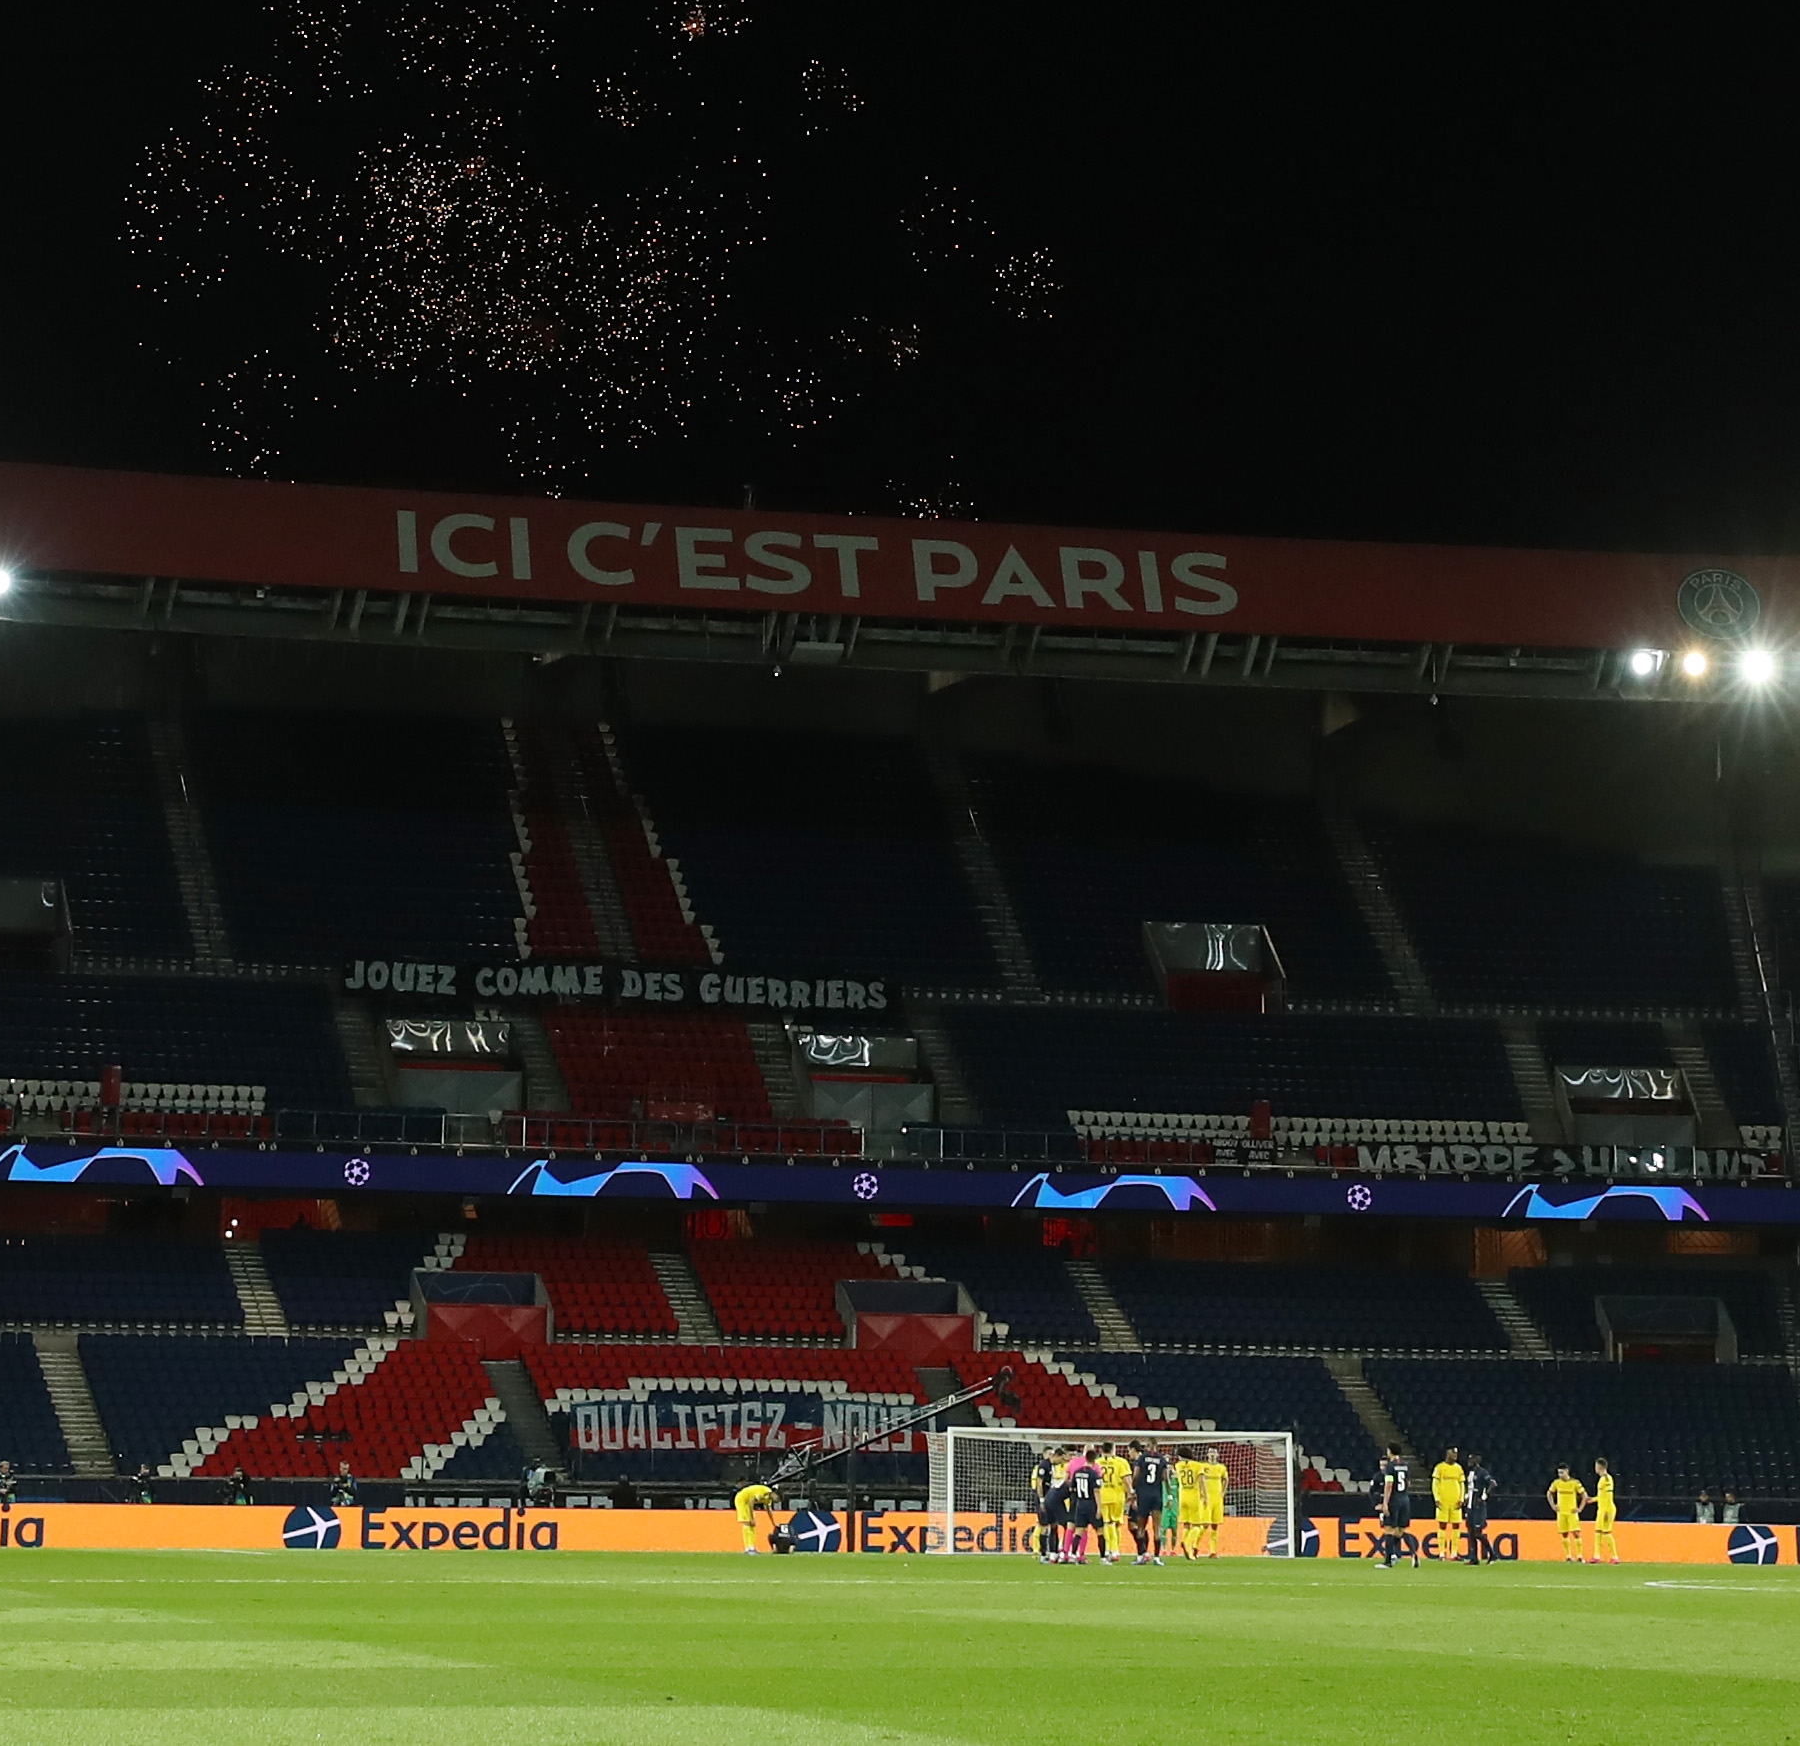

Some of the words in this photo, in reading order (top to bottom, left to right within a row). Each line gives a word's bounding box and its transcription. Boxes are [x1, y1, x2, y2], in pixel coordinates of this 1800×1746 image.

[396, 509, 531, 581] ICI
[567, 520, 880, 599] C'EST
[912, 537, 1240, 616] PARIS
[345, 960, 457, 996] JOUEZ
[475, 965, 603, 997] COMME
[620, 970, 685, 1002] DES
[699, 973, 888, 1010] GUERRIERS
[1146, 1463, 1157, 1484] 3
[1180, 1469, 1194, 1486] 28
[1397, 1471, 1406, 1492] 5
[1075, 1477, 1090, 1499] 14
[361, 1506, 558, 1550] Expedia
